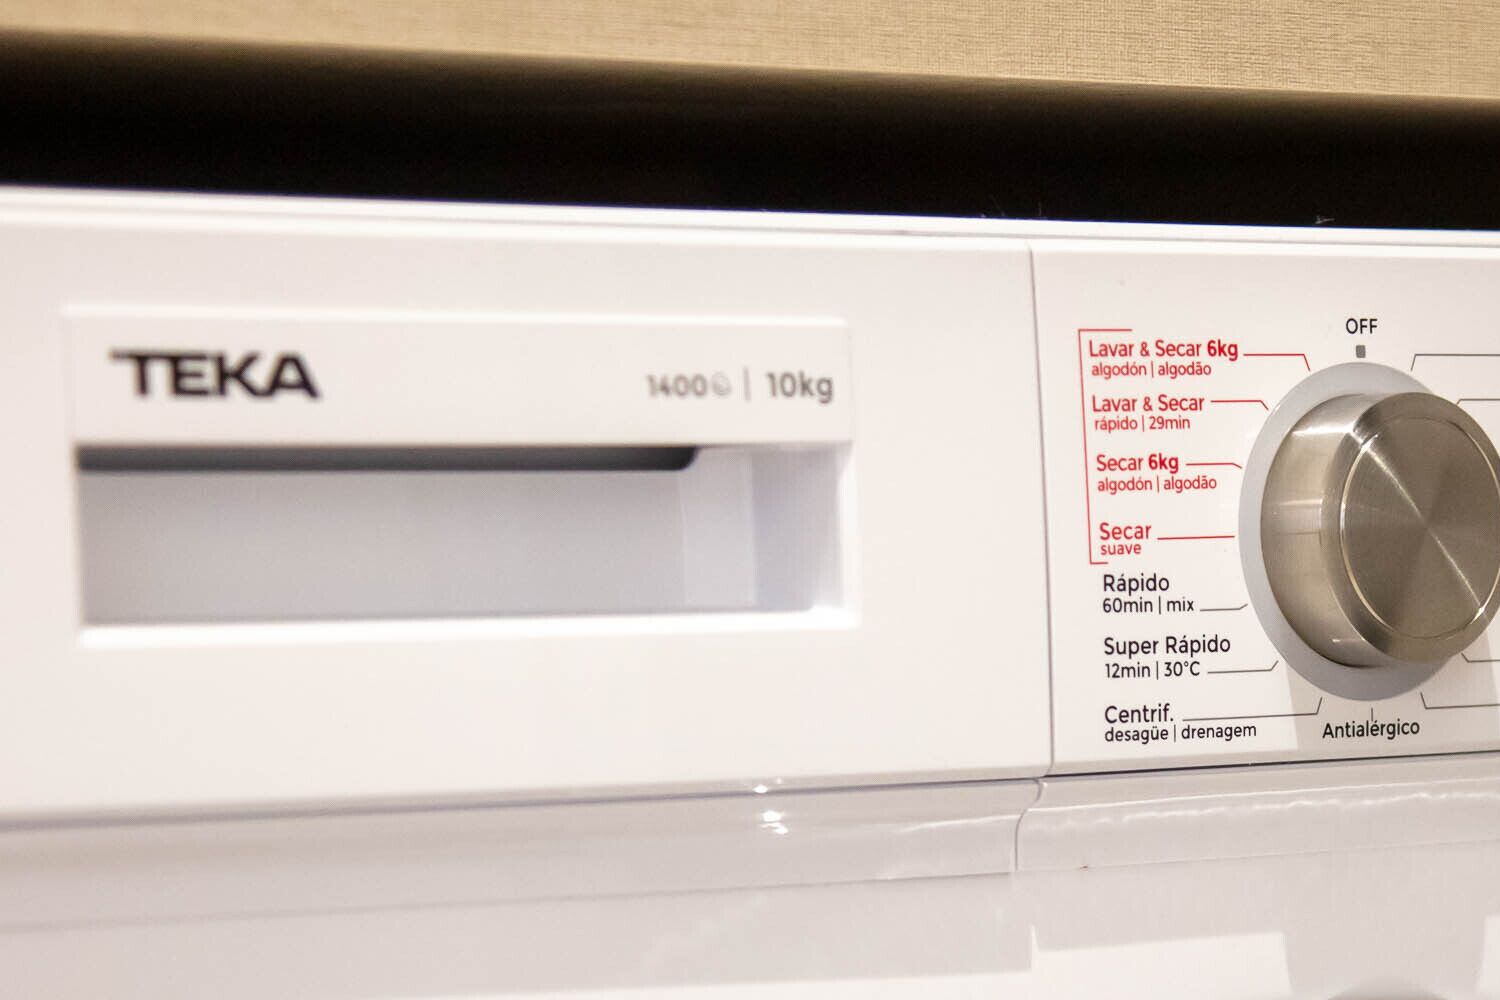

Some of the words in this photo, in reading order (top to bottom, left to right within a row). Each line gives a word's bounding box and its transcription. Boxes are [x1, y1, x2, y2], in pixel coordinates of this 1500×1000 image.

[1345, 318, 1378, 334] OFF
[1089, 340, 1136, 358] Lavar
[1140, 341, 1150, 357] &
[1155, 339, 1202, 357] Secar
[1207, 338, 1239, 361] 6kg
[109, 349, 322, 400] TEKA
[1091, 361, 1148, 379] algodón
[1158, 361, 1212, 379] algodão
[646, 372, 708, 398] 1400
[766, 369, 835, 404] 10kg
[1092, 395, 1139, 412] Lavar
[1143, 397, 1153, 412] &
[1159, 395, 1205, 412] Secar
[1094, 413, 1138, 433] rápido
[1149, 414, 1190, 430] 29min
[1096, 454, 1144, 471] Secar
[1149, 452, 1179, 475] 6kg
[1097, 477, 1153, 494] algodón
[1163, 475, 1217, 492] algodão
[1099, 522, 1152, 540] Secar
[1100, 542, 1142, 555] suave
[1103, 573, 1170, 596] Rápido
[1103, 598, 1154, 613] 60min
[1167, 598, 1194, 613] mix
[1104, 637, 1159, 659] Super
[1166, 634, 1231, 656] Rápido
[1105, 663, 1151, 678] 12min
[1164, 661, 1200, 677] 30°C
[1105, 705, 1174, 723] Centrif.
[1105, 726, 1169, 745] desagüe
[1182, 724, 1257, 742] drenagem
[1322, 718, 1420, 740] Antialérgico
